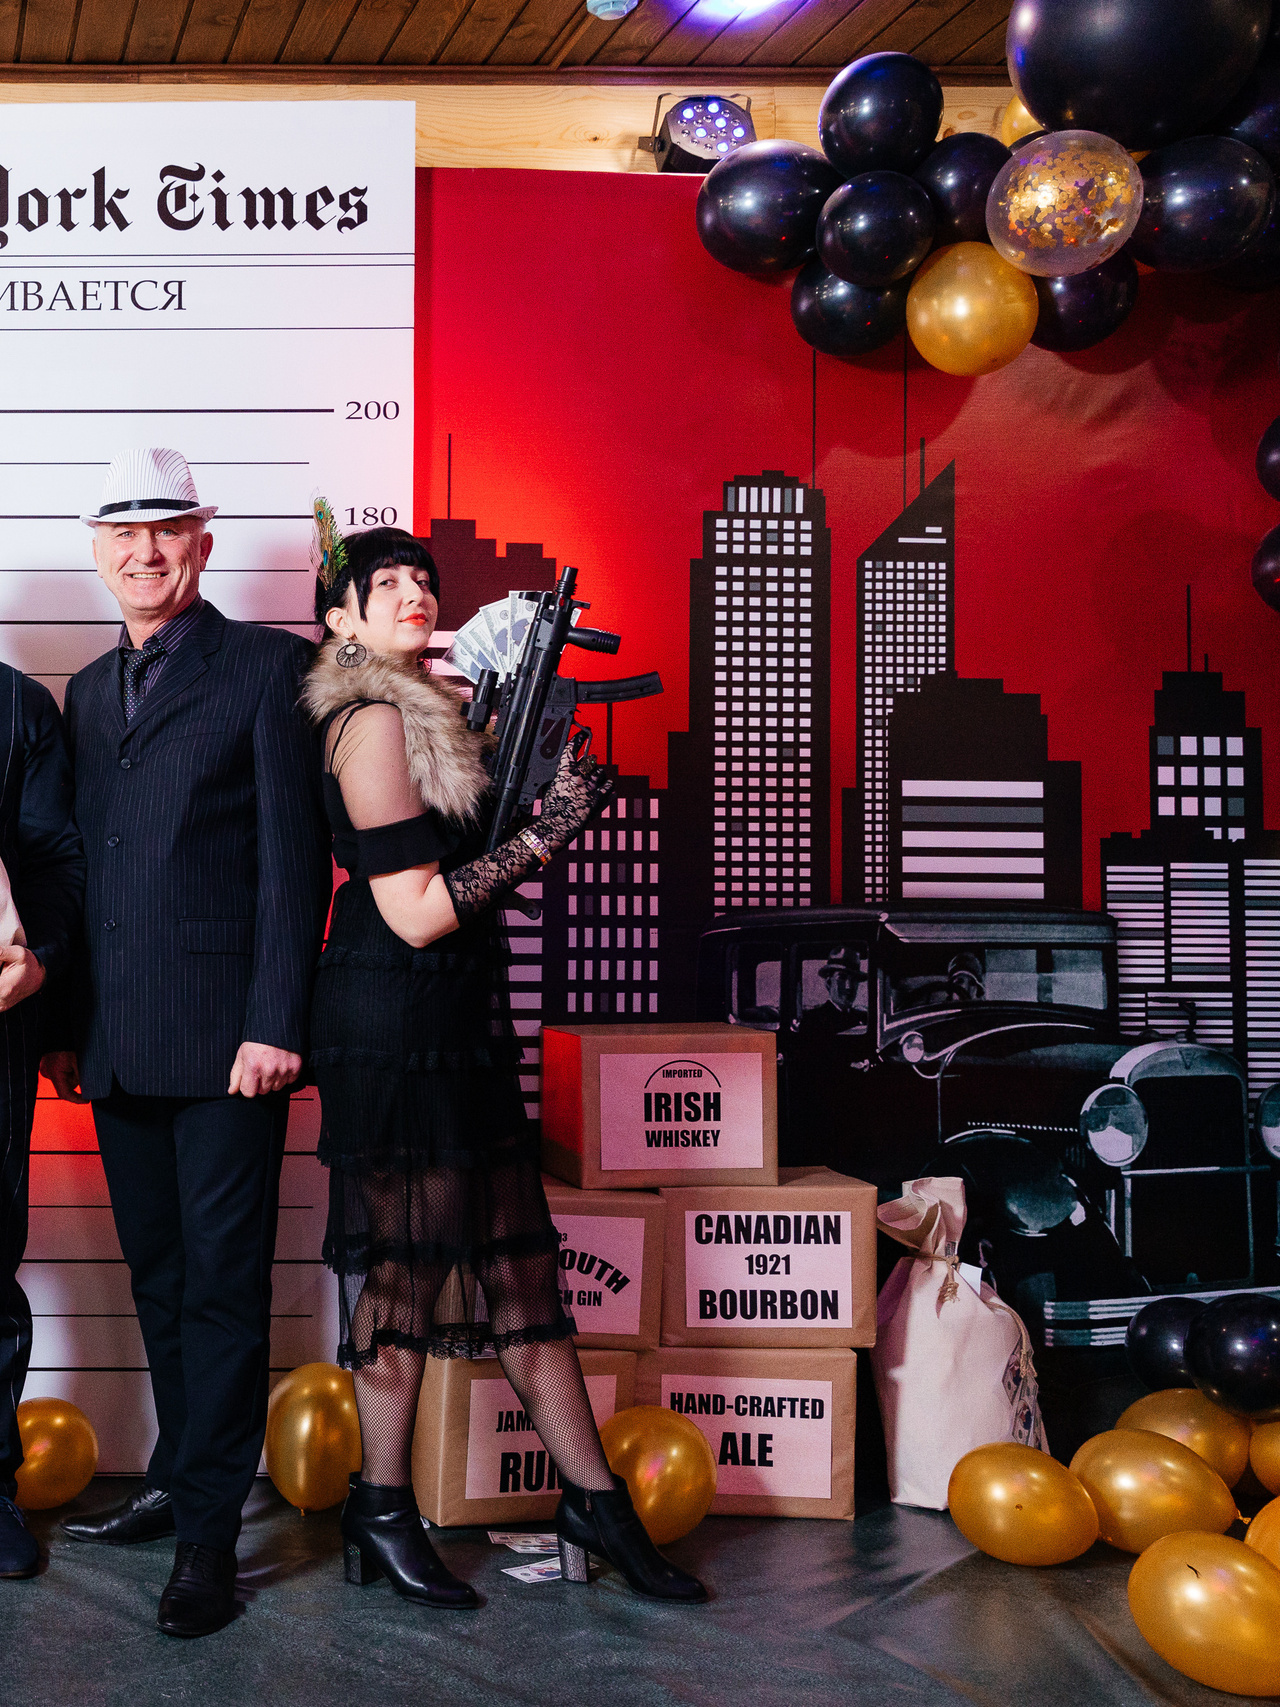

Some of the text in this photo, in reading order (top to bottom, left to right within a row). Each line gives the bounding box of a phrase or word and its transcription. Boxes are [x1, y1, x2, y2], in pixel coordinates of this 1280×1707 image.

[157, 162, 369, 234] Times
[345, 400, 401, 421] 200
[344, 506, 398, 526] 180
[662, 1069, 703, 1078] IMPORTED
[643, 1091, 722, 1122] IRISH
[644, 1129, 721, 1148] WHISKEY
[694, 1213, 842, 1245] CANADIAN
[559, 1248, 631, 1295] OUTH
[744, 1253, 791, 1275] 1921
[576, 1289, 603, 1307] GIN
[698, 1288, 839, 1321] BOURBON
[670, 1392, 825, 1420] HAND-CRAFTED
[718, 1431, 774, 1468] ALE
